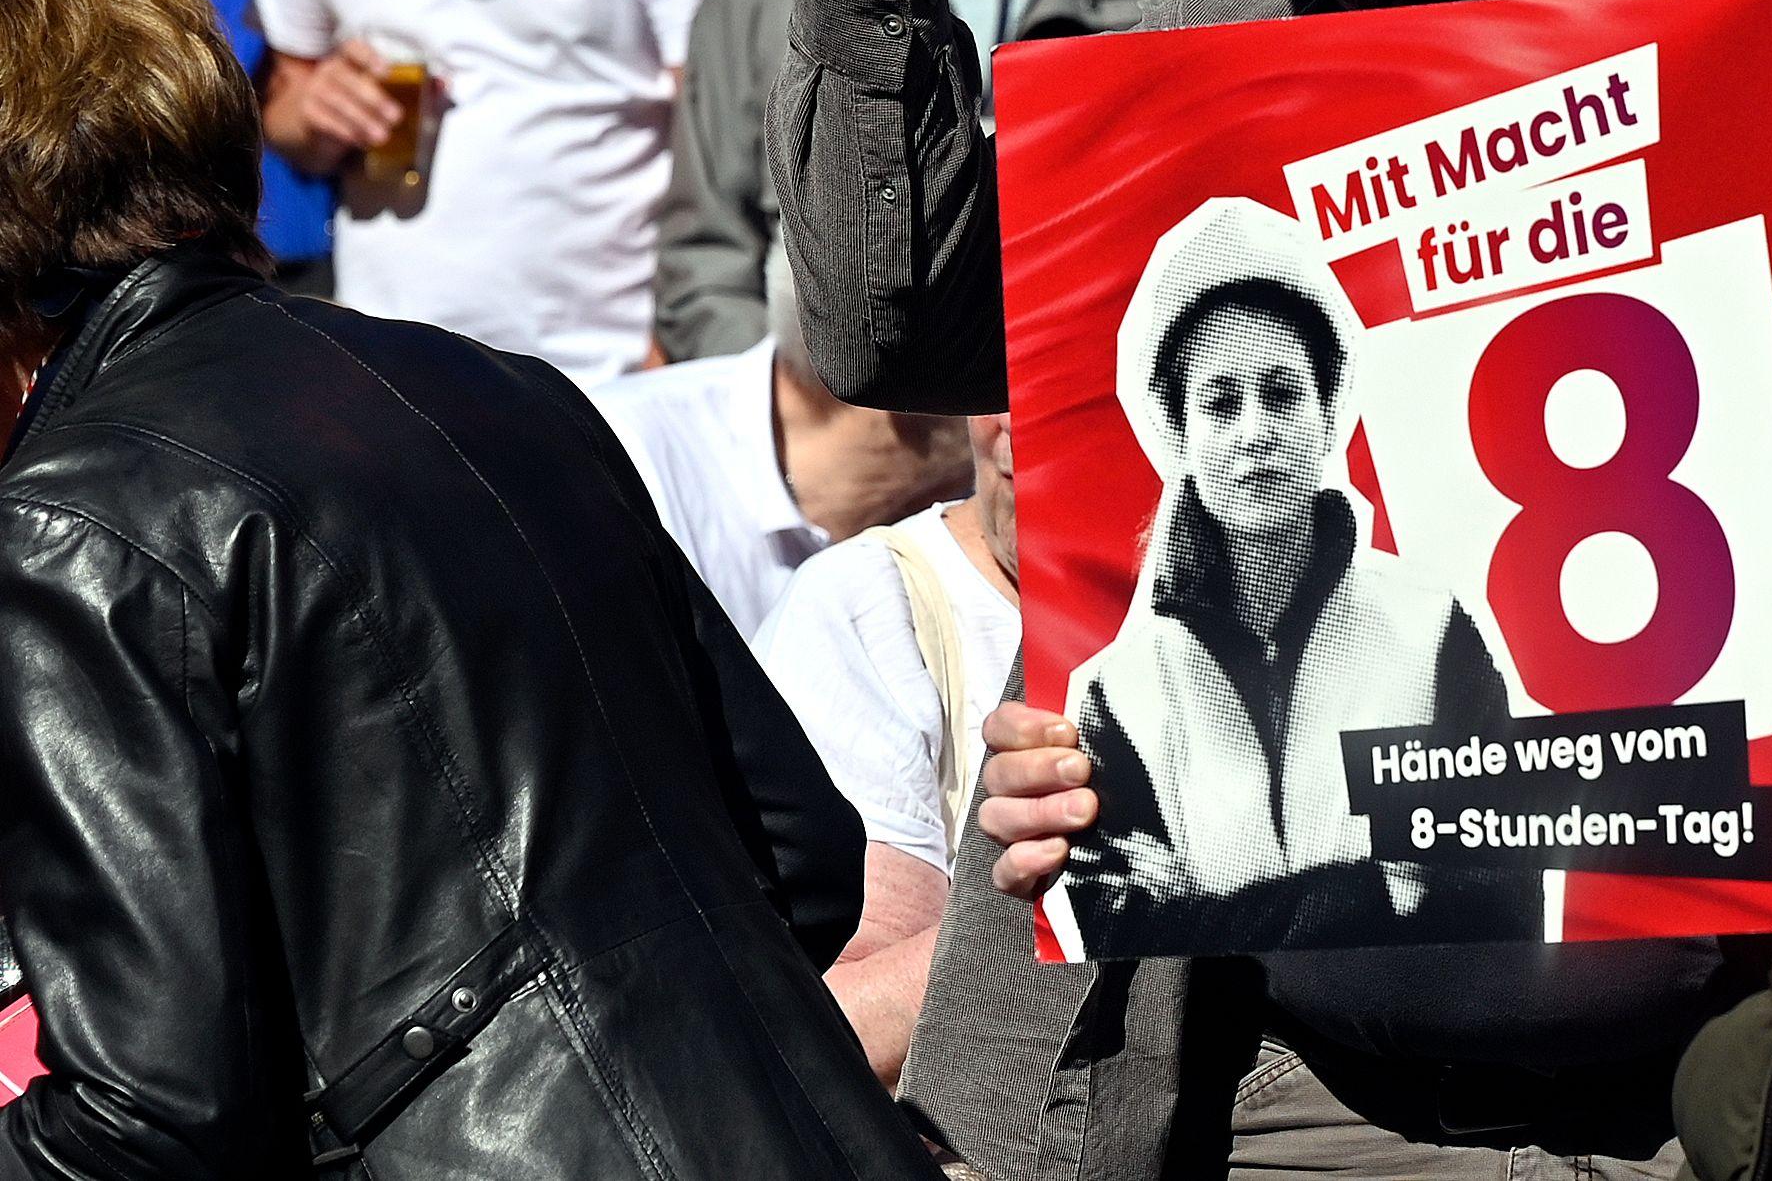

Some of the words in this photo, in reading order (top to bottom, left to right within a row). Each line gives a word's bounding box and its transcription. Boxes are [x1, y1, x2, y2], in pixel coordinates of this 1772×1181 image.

[1311, 156, 1417, 241] Mit
[1425, 73, 1638, 198] Macht
[1417, 221, 1510, 292] für
[1528, 191, 1629, 264] die
[1468, 292, 1735, 716] 8
[1371, 735, 1508, 785] Hände
[1513, 733, 1603, 780] weg
[1610, 723, 1708, 764] vom
[1410, 801, 1755, 858] 8-Stunden-Tag!
